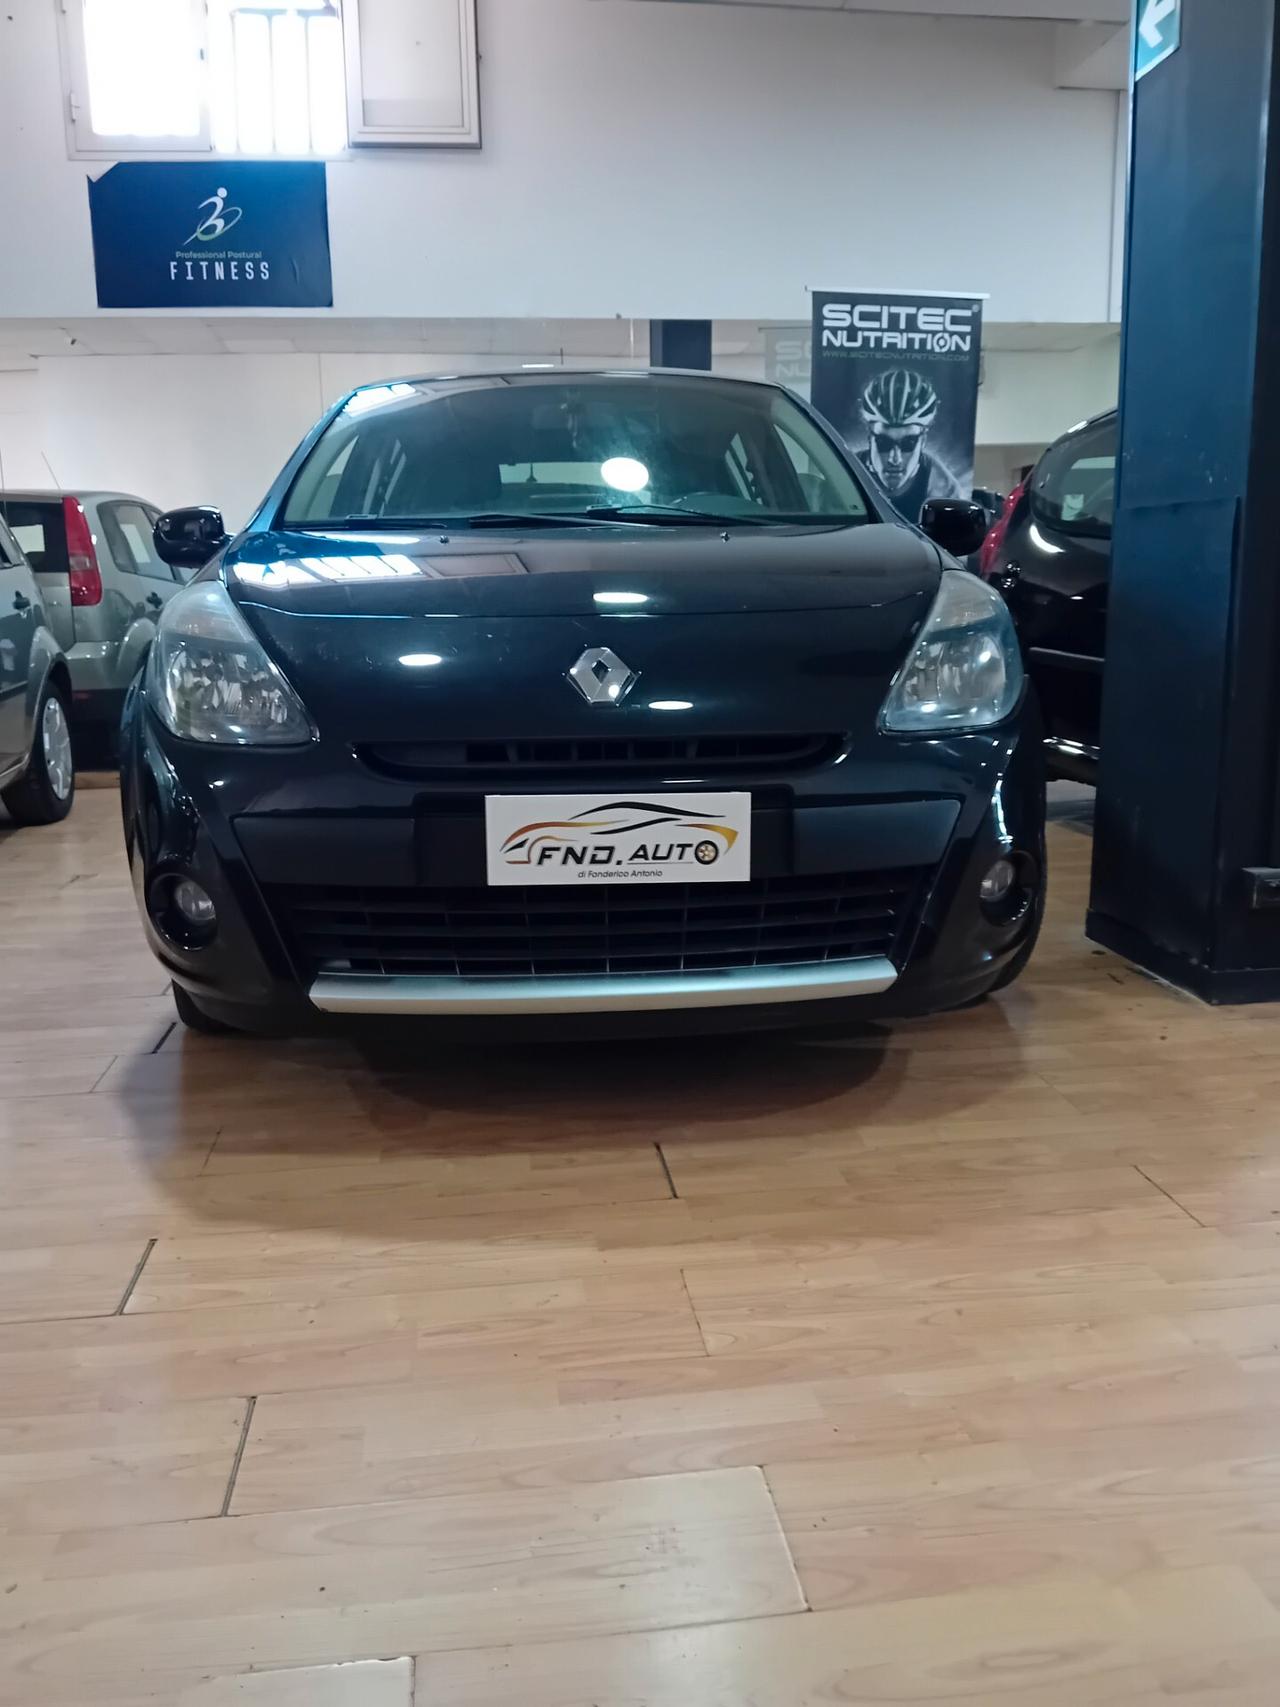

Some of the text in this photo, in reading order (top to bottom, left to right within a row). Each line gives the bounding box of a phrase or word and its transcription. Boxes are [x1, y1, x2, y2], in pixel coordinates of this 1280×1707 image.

[175, 250, 262, 259] Professional Postural
[170, 261, 269, 281] FITNESS
[822, 303, 972, 332] SCITEC
[822, 330, 971, 353] NUTRITION
[577, 870, 587, 878] di
[630, 869, 663, 878] Antonio
